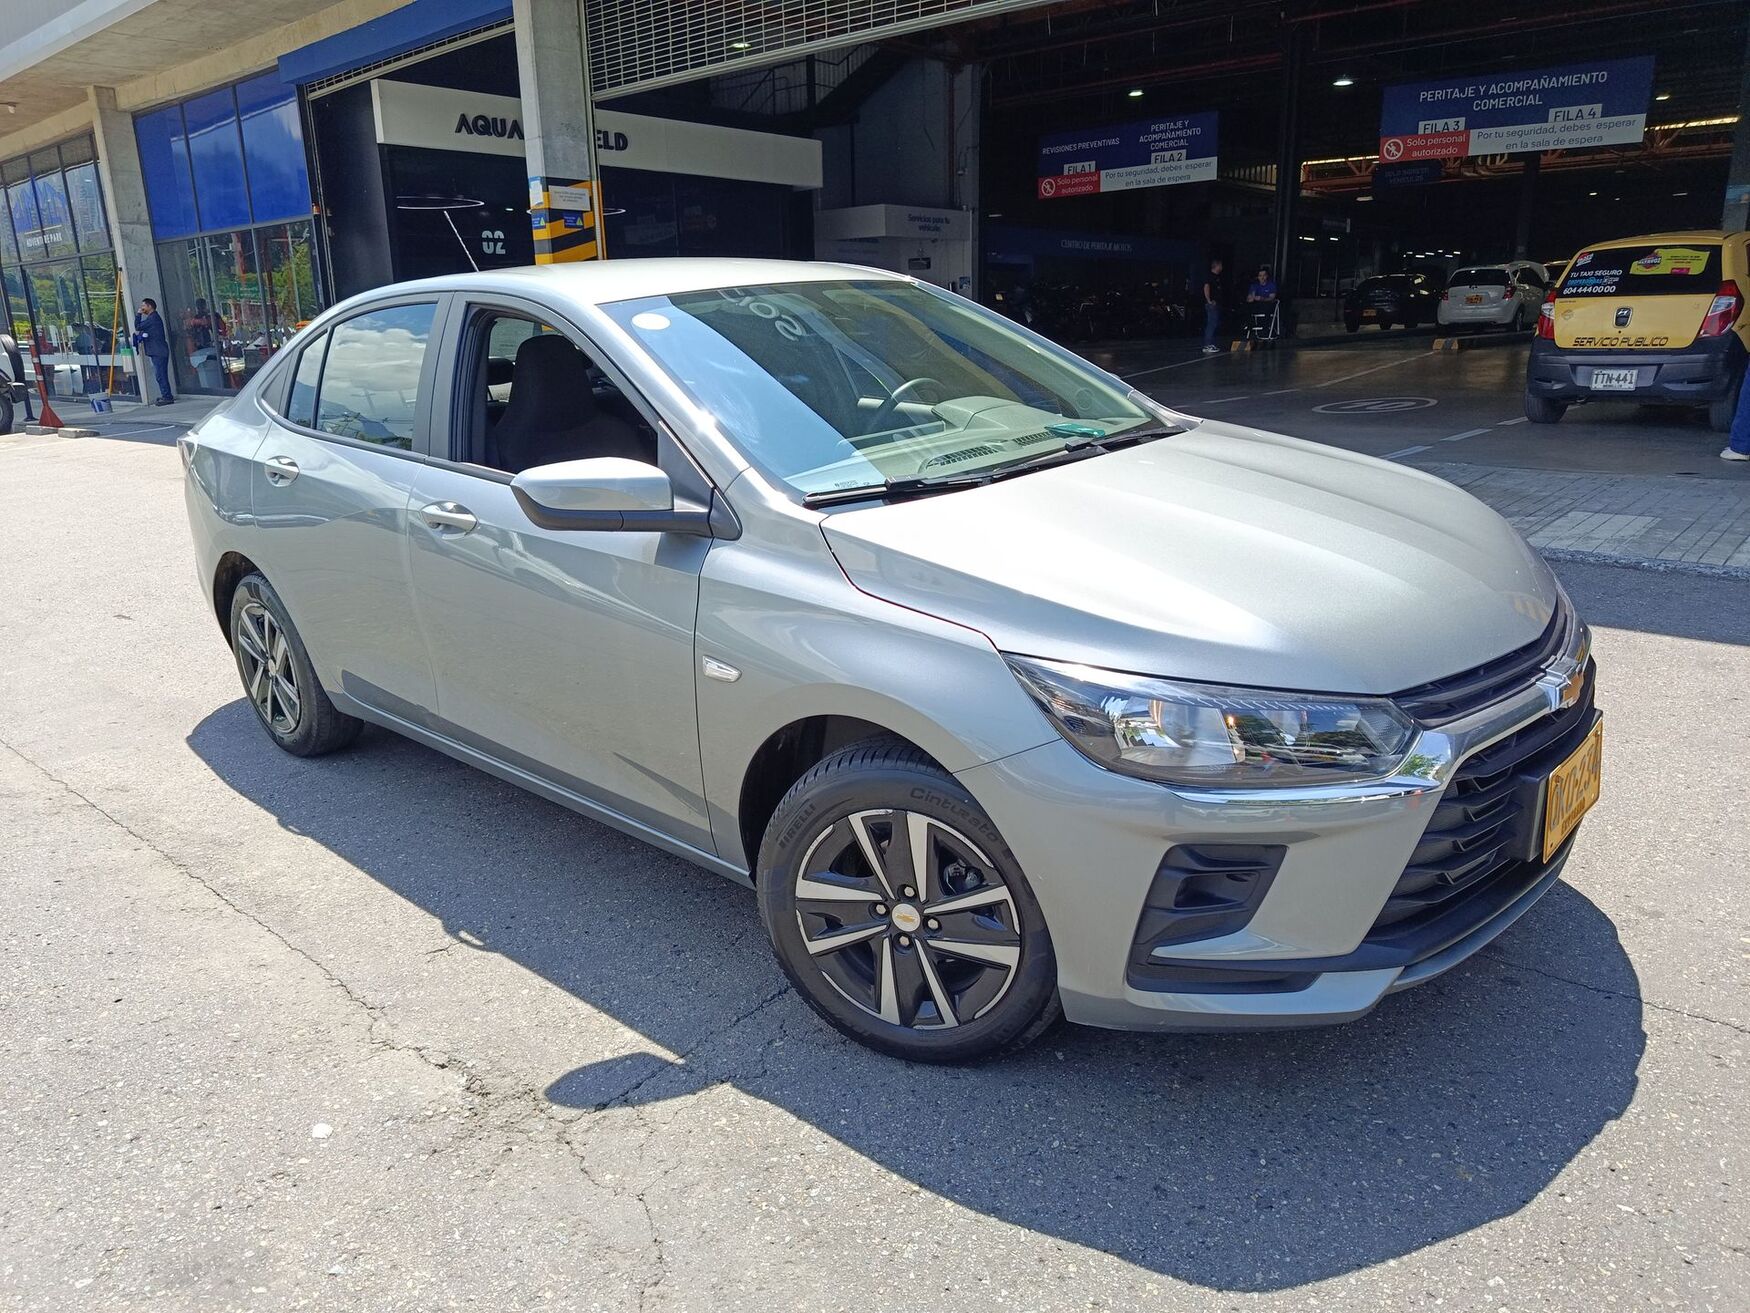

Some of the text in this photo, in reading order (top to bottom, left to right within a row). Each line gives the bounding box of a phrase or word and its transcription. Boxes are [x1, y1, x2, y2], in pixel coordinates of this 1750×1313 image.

[1420, 71, 1608, 102] PERITAJE Y ACOMPAÑAMIENTO
[1473, 94, 1544, 111] COMERCIAL
[1554, 108, 1597, 122] FILA 4
[455, 113, 524, 140] AQUA
[1151, 121, 1182, 132] PERITAJE
[1423, 120, 1460, 134] FILA 3
[1477, 118, 1636, 140] Por tu seguridad, debes esperar
[1139, 128, 1202, 143] ACOMPAÑAMIENTO
[1406, 134, 1466, 147] Solo personal
[1042, 138, 1120, 154] REVISIONES PREVENTIVAS
[1150, 139, 1189, 150] COMERCIAL
[1505, 134, 1604, 150] en la sala de espera
[1154, 152, 1182, 164] FILA 2
[1412, 146, 1458, 158] autorizado
[1068, 165, 1086, 174] FILA
[1161, 164, 1182, 173] debes
[1184, 161, 1212, 172] esperar
[1057, 174, 1098, 186] Solo personal
[1143, 176, 1155, 185] sala
[1158, 176, 1166, 184] de
[1168, 174, 1191, 184] espera
[1062, 185, 1093, 194] autorizado
[1572, 337, 1668, 347] SERVICIO PUBLICO
